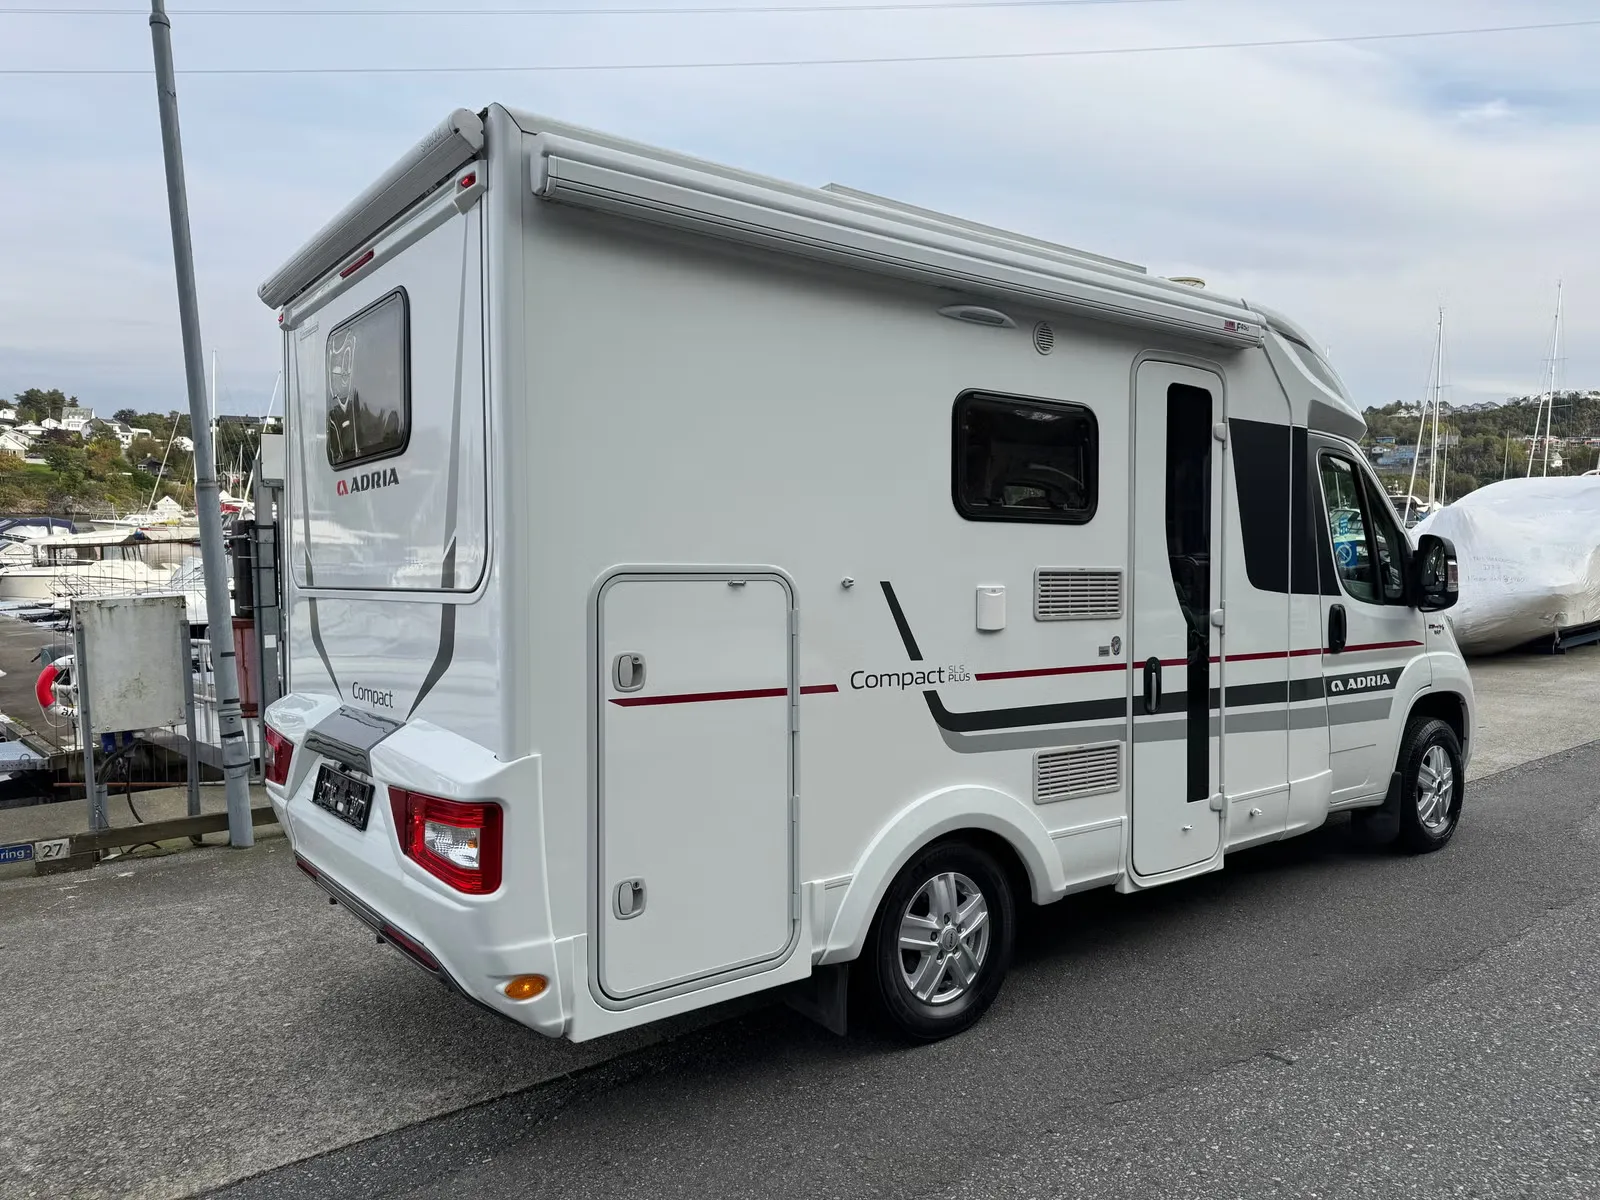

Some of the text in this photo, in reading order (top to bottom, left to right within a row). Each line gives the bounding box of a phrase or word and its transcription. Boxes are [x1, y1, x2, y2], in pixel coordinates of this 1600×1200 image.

[350, 467, 400, 493] ADRIA
[948, 665, 965, 674] SLS
[948, 673, 971, 682] PLUS
[850, 666, 945, 690] Compact
[1347, 674, 1391, 690] ADRIA
[352, 681, 394, 709] Compact
[43, 843, 63, 858] 27
